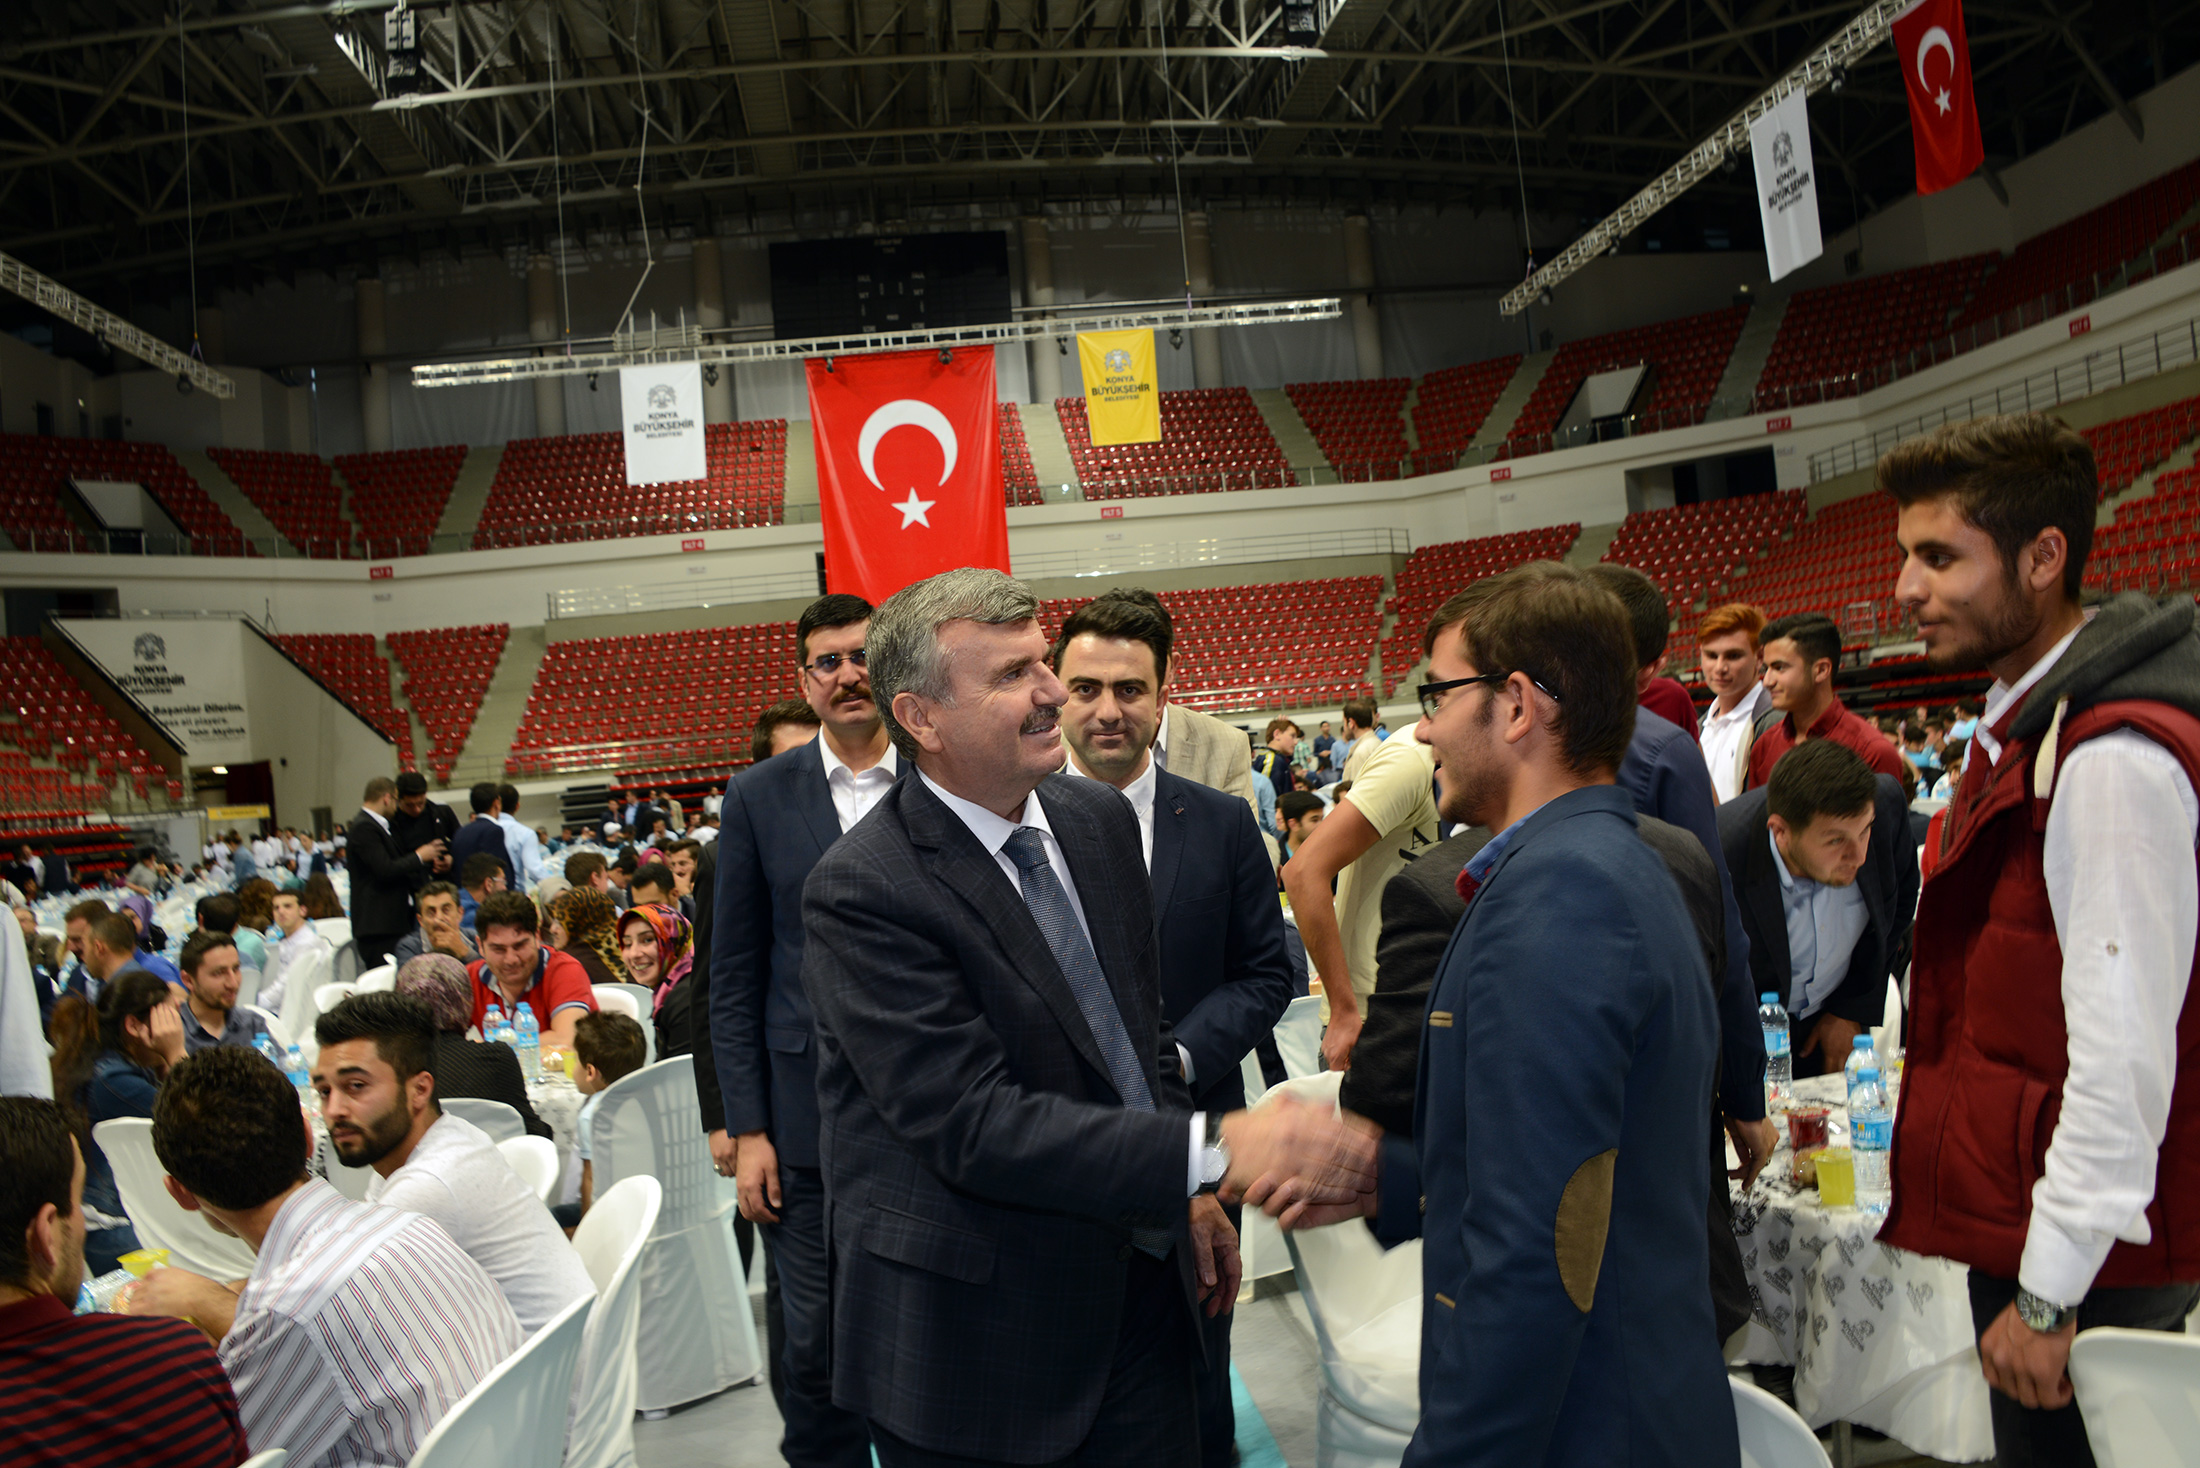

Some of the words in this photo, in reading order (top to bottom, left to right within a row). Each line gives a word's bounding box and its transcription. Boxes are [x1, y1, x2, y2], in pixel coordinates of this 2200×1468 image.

[1776, 167, 1797, 185] KONYA
[1768, 172, 1810, 209] BÜYÜKŞEHİR
[1105, 376, 1135, 384] KONYA
[1092, 384, 1150, 396] BÜYÜKŞEHİR
[1104, 394, 1140, 402] BELEDİYESİ
[648, 411, 678, 420] KONYA
[633, 418, 694, 433] BÜYÜKŞEHİR
[134, 664, 167, 675] KONYA
